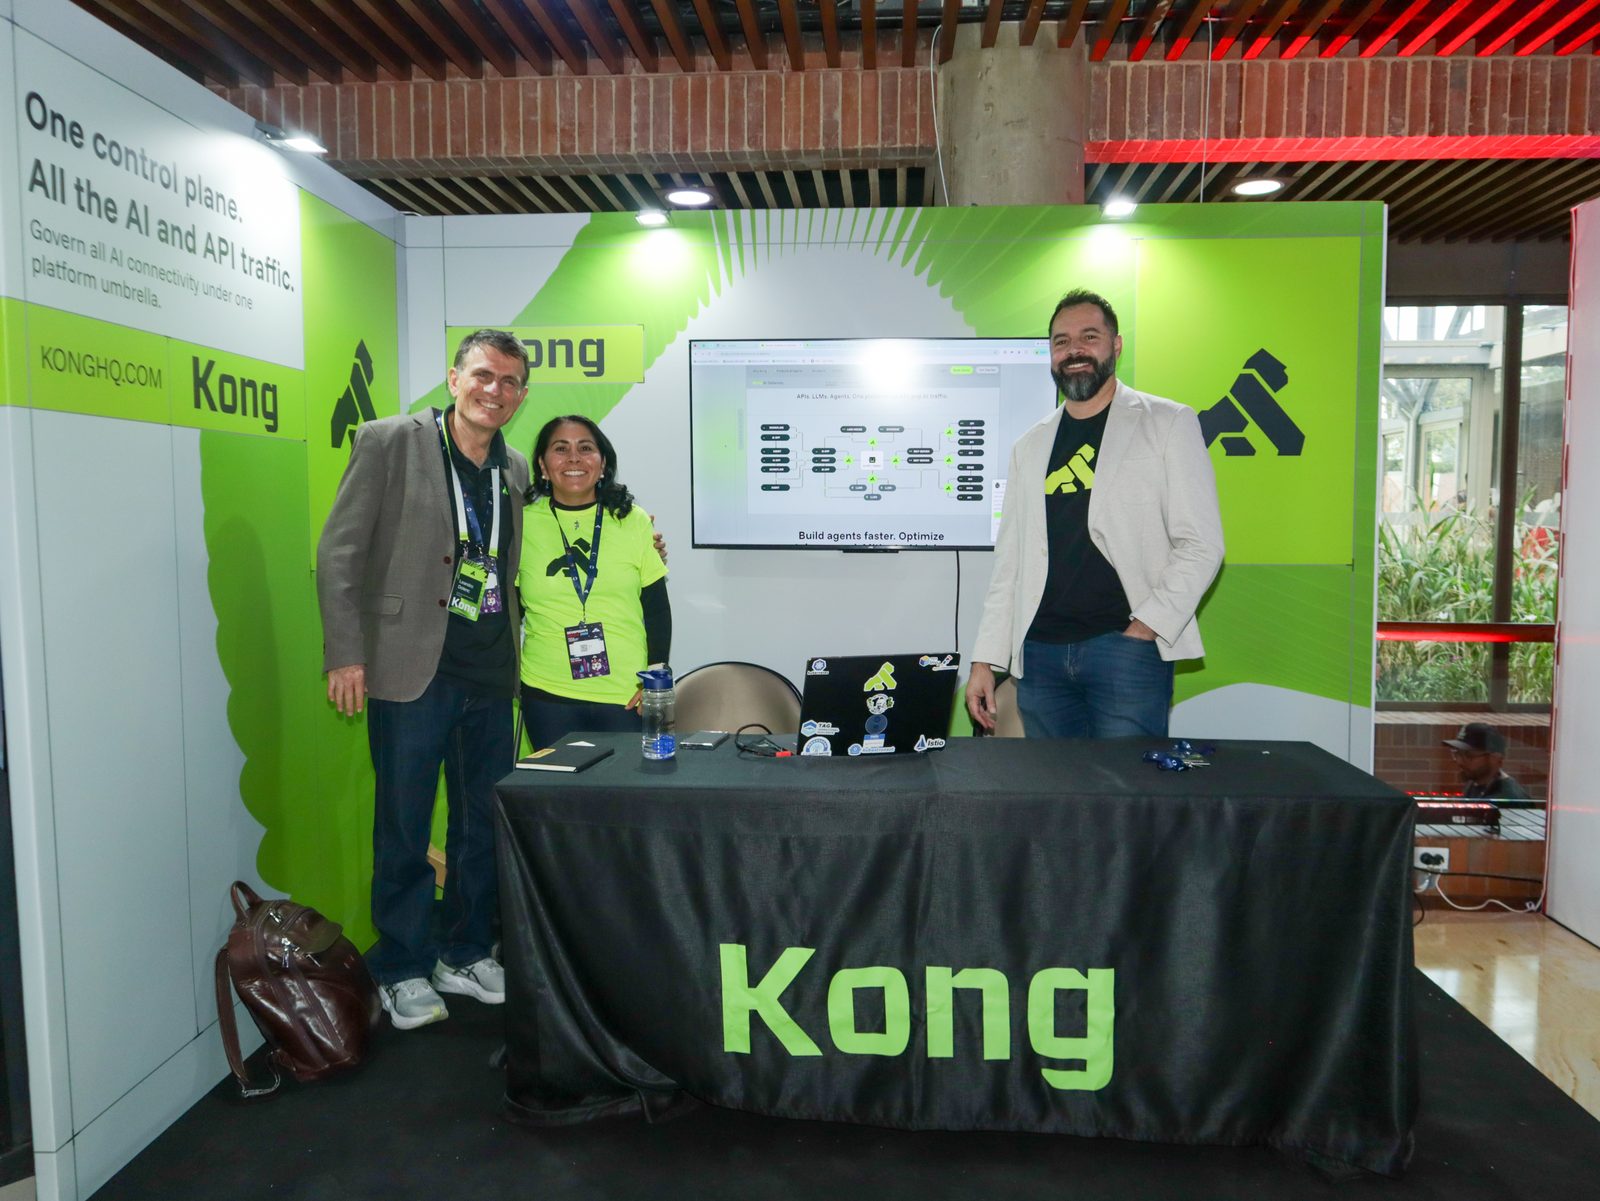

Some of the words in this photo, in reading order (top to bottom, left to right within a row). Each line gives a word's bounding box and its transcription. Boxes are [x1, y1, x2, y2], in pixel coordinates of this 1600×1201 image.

[25, 91, 84, 149] One
[93, 132, 178, 194] control
[184, 174, 243, 223] plane.
[28, 158, 66, 205] All
[73, 176, 118, 224] the
[126, 199, 150, 237] AI
[157, 218, 197, 255] and
[203, 232, 236, 269] API
[241, 247, 295, 293] traffic.
[30, 218, 87, 252] Govern
[90, 240, 107, 260] all
[110, 246, 124, 267] AI
[127, 254, 201, 296] connectivity
[202, 280, 233, 304] under
[235, 294, 253, 310] one
[32, 254, 97, 290] platform
[101, 277, 163, 309] umbrella.
[40, 344, 163, 390] KONGHQ.COM
[503, 332, 605, 377] ong
[192, 355, 279, 433] Kong
[798, 531, 824, 540] Build
[827, 532, 862, 542] agents
[864, 531, 896, 540] faster.
[898, 531, 945, 542] Optimize
[451, 596, 477, 617] Kong
[927, 739, 945, 747] Istio
[719, 943, 1116, 1091] Kong
